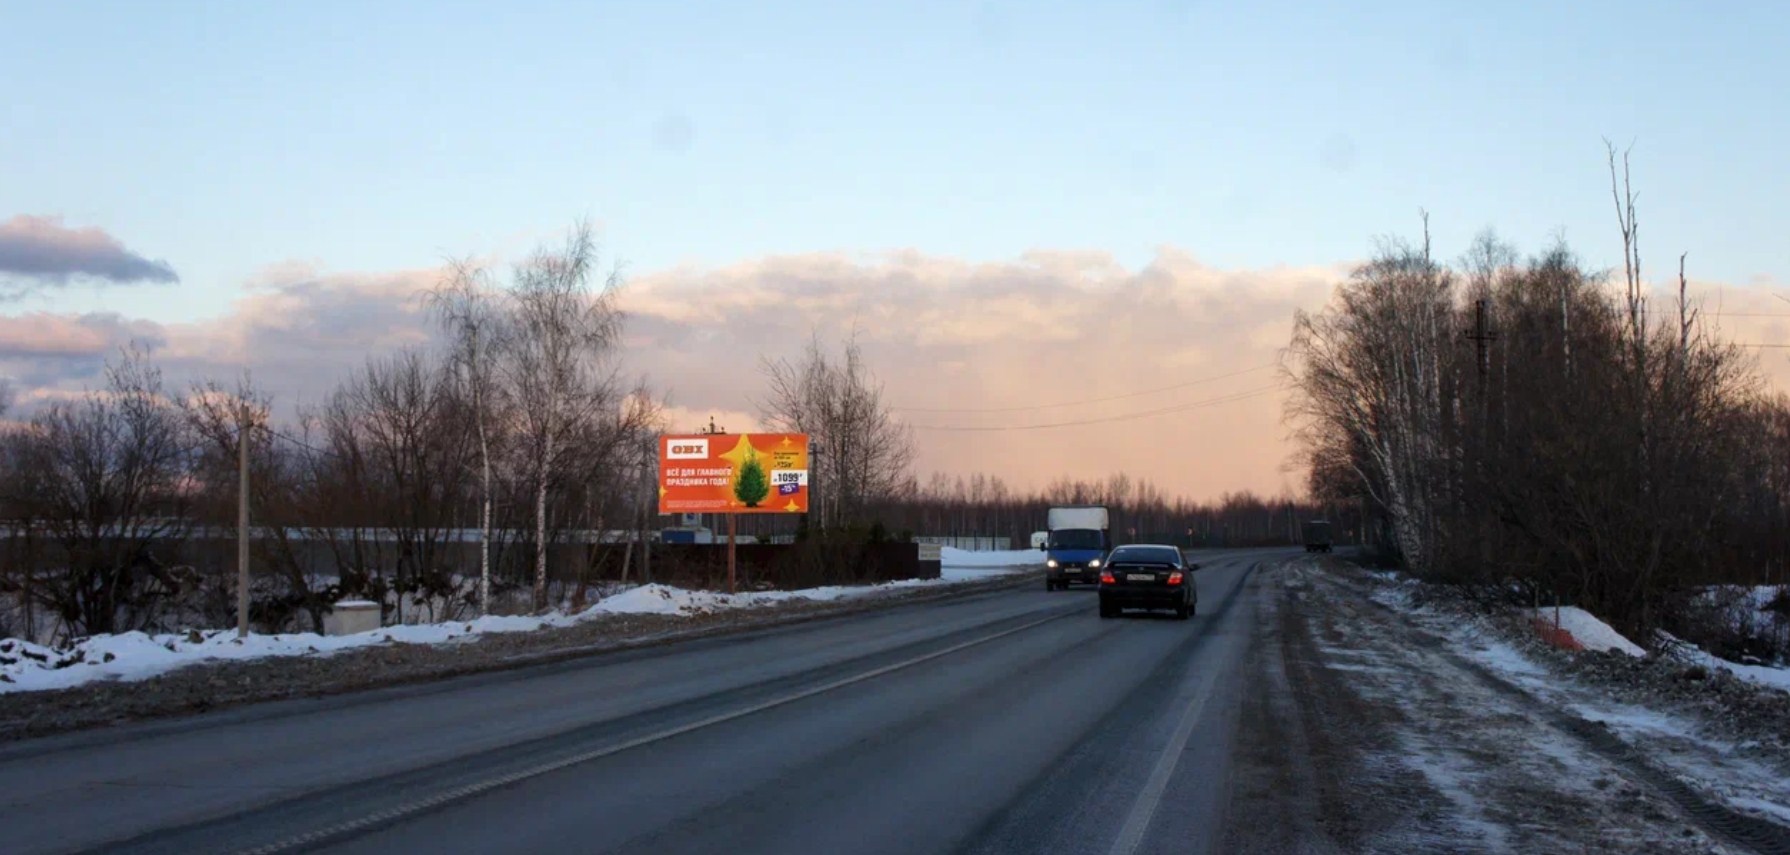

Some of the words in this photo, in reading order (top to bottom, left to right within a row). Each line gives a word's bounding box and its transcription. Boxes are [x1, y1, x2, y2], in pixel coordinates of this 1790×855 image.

[671, 445, 703, 454] OBI
[666, 467, 679, 477] ВСЁ
[681, 468, 695, 477] ДЛЯ
[697, 468, 732, 477] ГЛАВНОГО
[666, 478, 708, 486] ПРАЗДНИКА
[710, 478, 729, 486] ГОДА!
[778, 473, 799, 482] 1099
